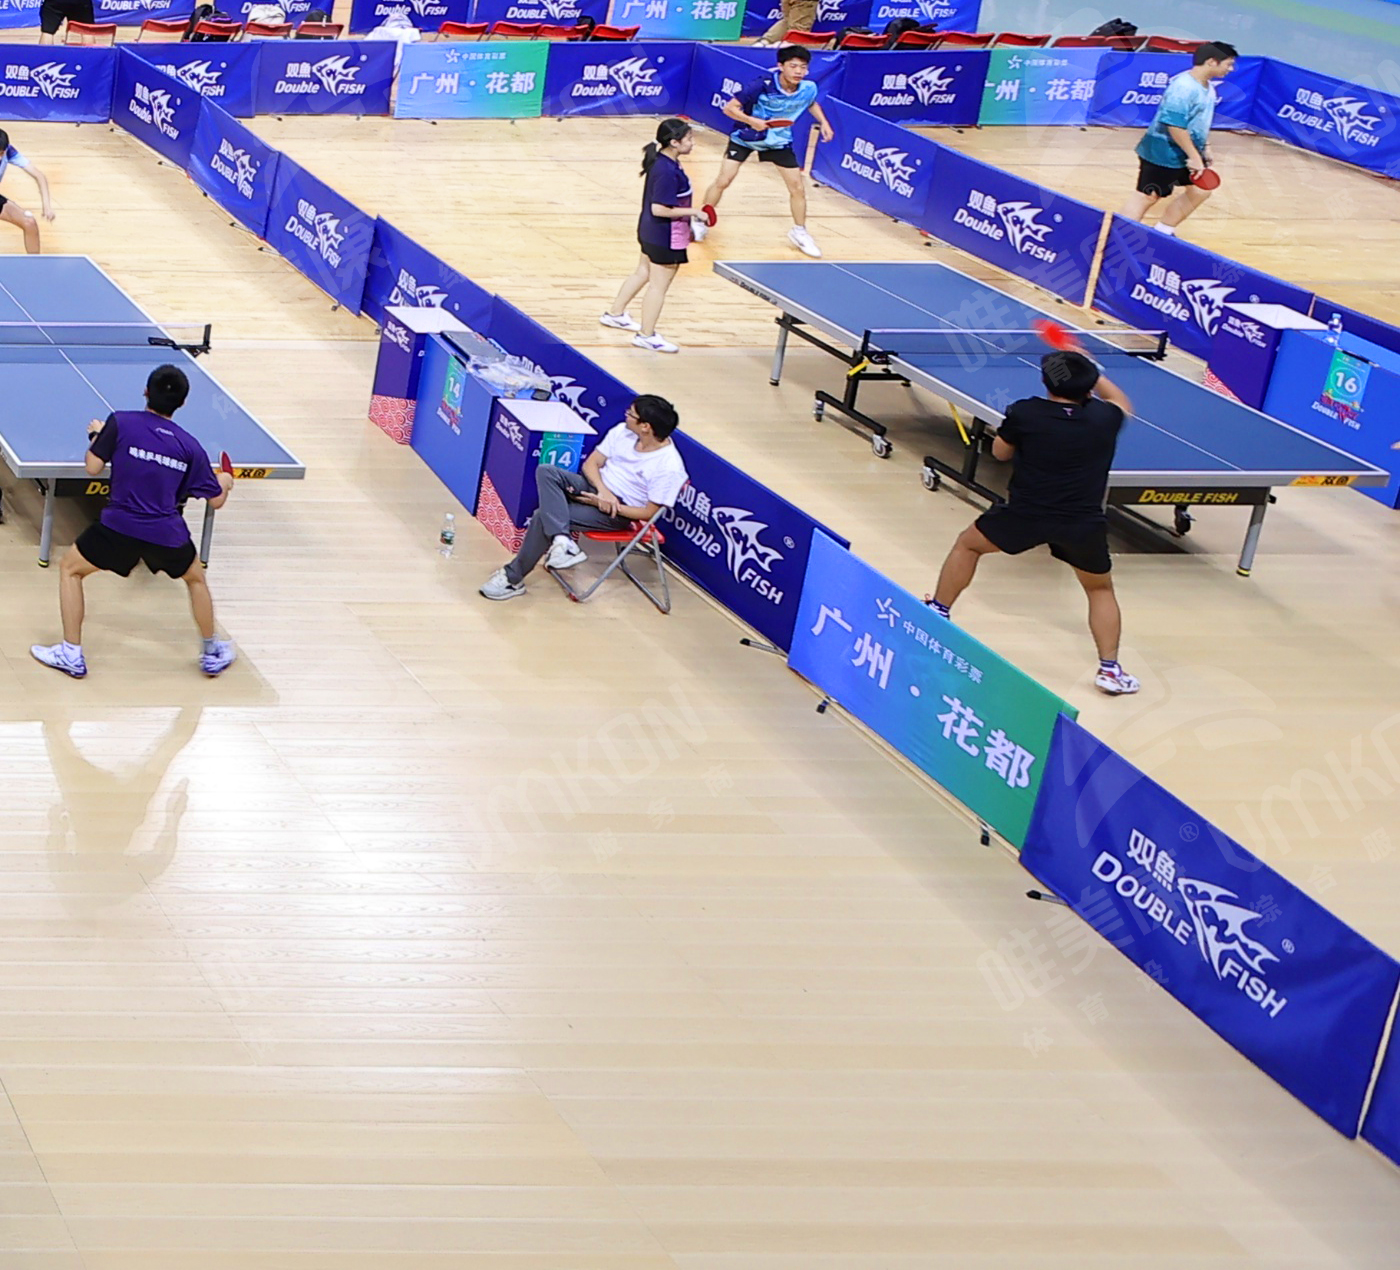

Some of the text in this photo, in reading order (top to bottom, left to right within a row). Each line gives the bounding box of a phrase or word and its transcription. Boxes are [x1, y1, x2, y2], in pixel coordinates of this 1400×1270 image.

[556, 6, 582, 19] FISH
[51, 86, 80, 99] FISH
[409, 70, 537, 96] 广州·花都
[1349, 127, 1381, 148] FISH
[322, 246, 341, 269] FISH
[1020, 238, 1059, 265] FISH
[448, 376, 462, 398] 14
[1334, 370, 1358, 391] 16
[548, 449, 572, 468] 14
[1138, 489, 1240, 505] DOUBLE FISH
[739, 567, 785, 606] FISH
[810, 604, 1036, 791] 广州·花都
[1091, 849, 1288, 1020] DOUBLE FISH
